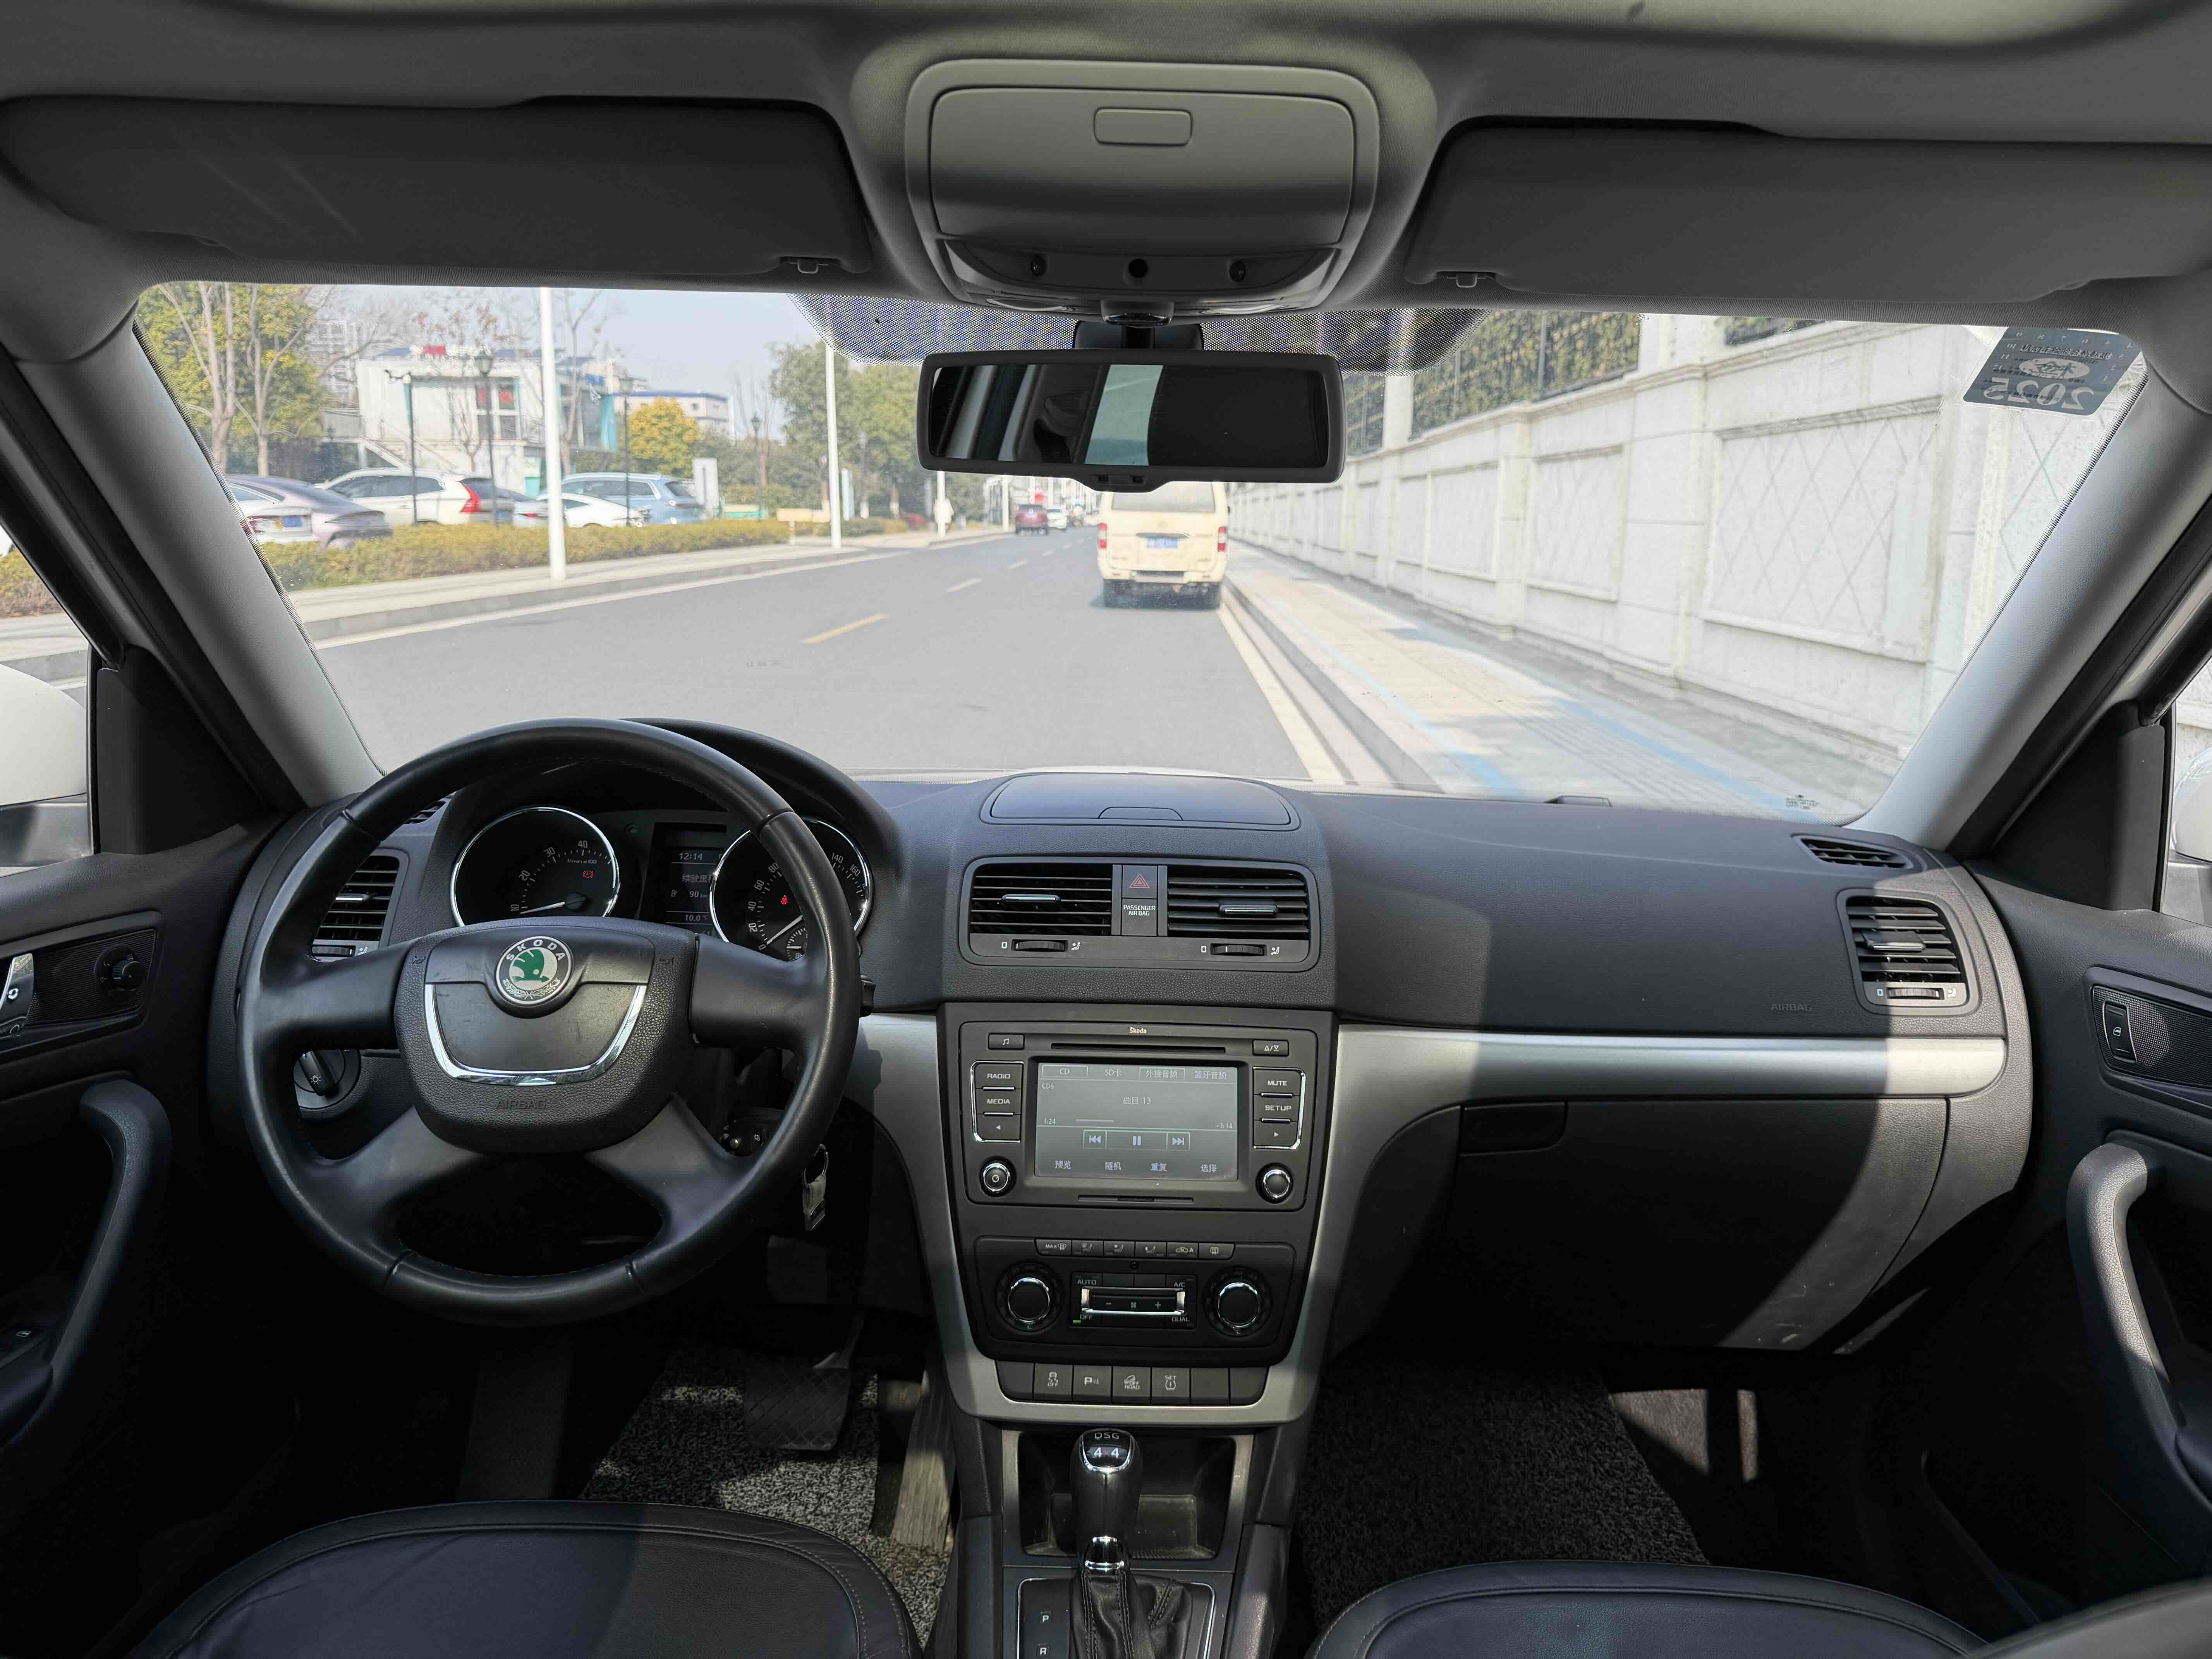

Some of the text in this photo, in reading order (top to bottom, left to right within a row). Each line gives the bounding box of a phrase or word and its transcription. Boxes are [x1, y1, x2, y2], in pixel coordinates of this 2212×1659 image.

[578, 840, 588, 848] 40
[543, 847, 556, 857] 30
[831, 853, 843, 864] 140
[768, 862, 780, 873] 80
[850, 864, 860, 876] 160
[519, 870, 530, 881] 20
[754, 879, 764, 890] 60
[748, 901, 756, 911] 40
[748, 923, 758, 933] 20
[1771, 1003, 1813, 1012] AIRBAG
[1104, 1068, 1122, 1077] SD卡
[1146, 1069, 1178, 1079] 外接音频
[1194, 1071, 1227, 1080] 蓝牙音频
[496, 1099, 548, 1110] AIRBAG
[1123, 1096, 1139, 1105] 曲目
[1054, 1160, 1072, 1170] 预览
[1104, 1161, 1122, 1171] 随机
[1151, 1163, 1167, 1172] 重复
[1200, 1164, 1218, 1173] 选择
[1094, 1432, 1120, 1440] DSG
